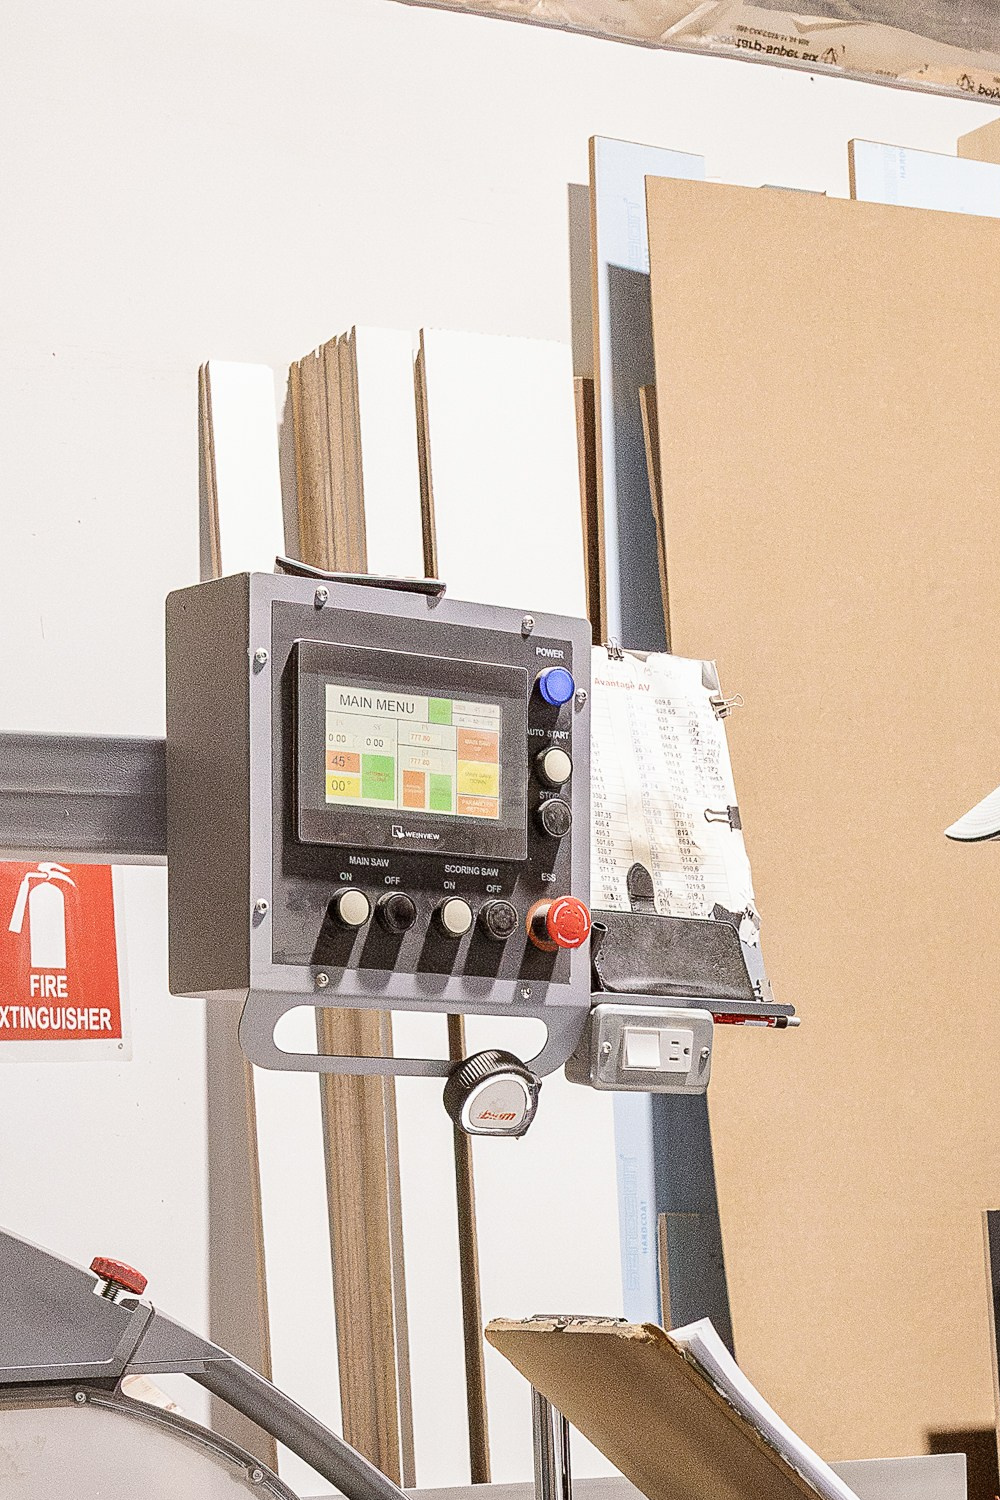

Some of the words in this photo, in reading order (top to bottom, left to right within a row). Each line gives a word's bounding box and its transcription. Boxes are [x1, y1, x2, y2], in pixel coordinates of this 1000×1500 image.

[535, 647, 565, 659] POWER
[638, 683, 651, 692] AV
[339, 693, 373, 708] MAIN
[376, 698, 415, 715] MENU
[547, 730, 570, 740] START
[349, 855, 370, 867] MAIN
[370, 857, 390, 868] SAW
[444, 864, 480, 876] SCORING
[481, 867, 499, 878] SAW
[339, 872, 353, 882] ON
[384, 876, 401, 886] OFF
[541, 872, 557, 883] ESS
[443, 881, 456, 890] ON
[486, 884, 502, 893] OFF
[29, 974, 69, 998] FIRE
[0, 1005, 113, 1031] XTINGUISHER
[640, 1200, 649, 1254] HARDCOAT
